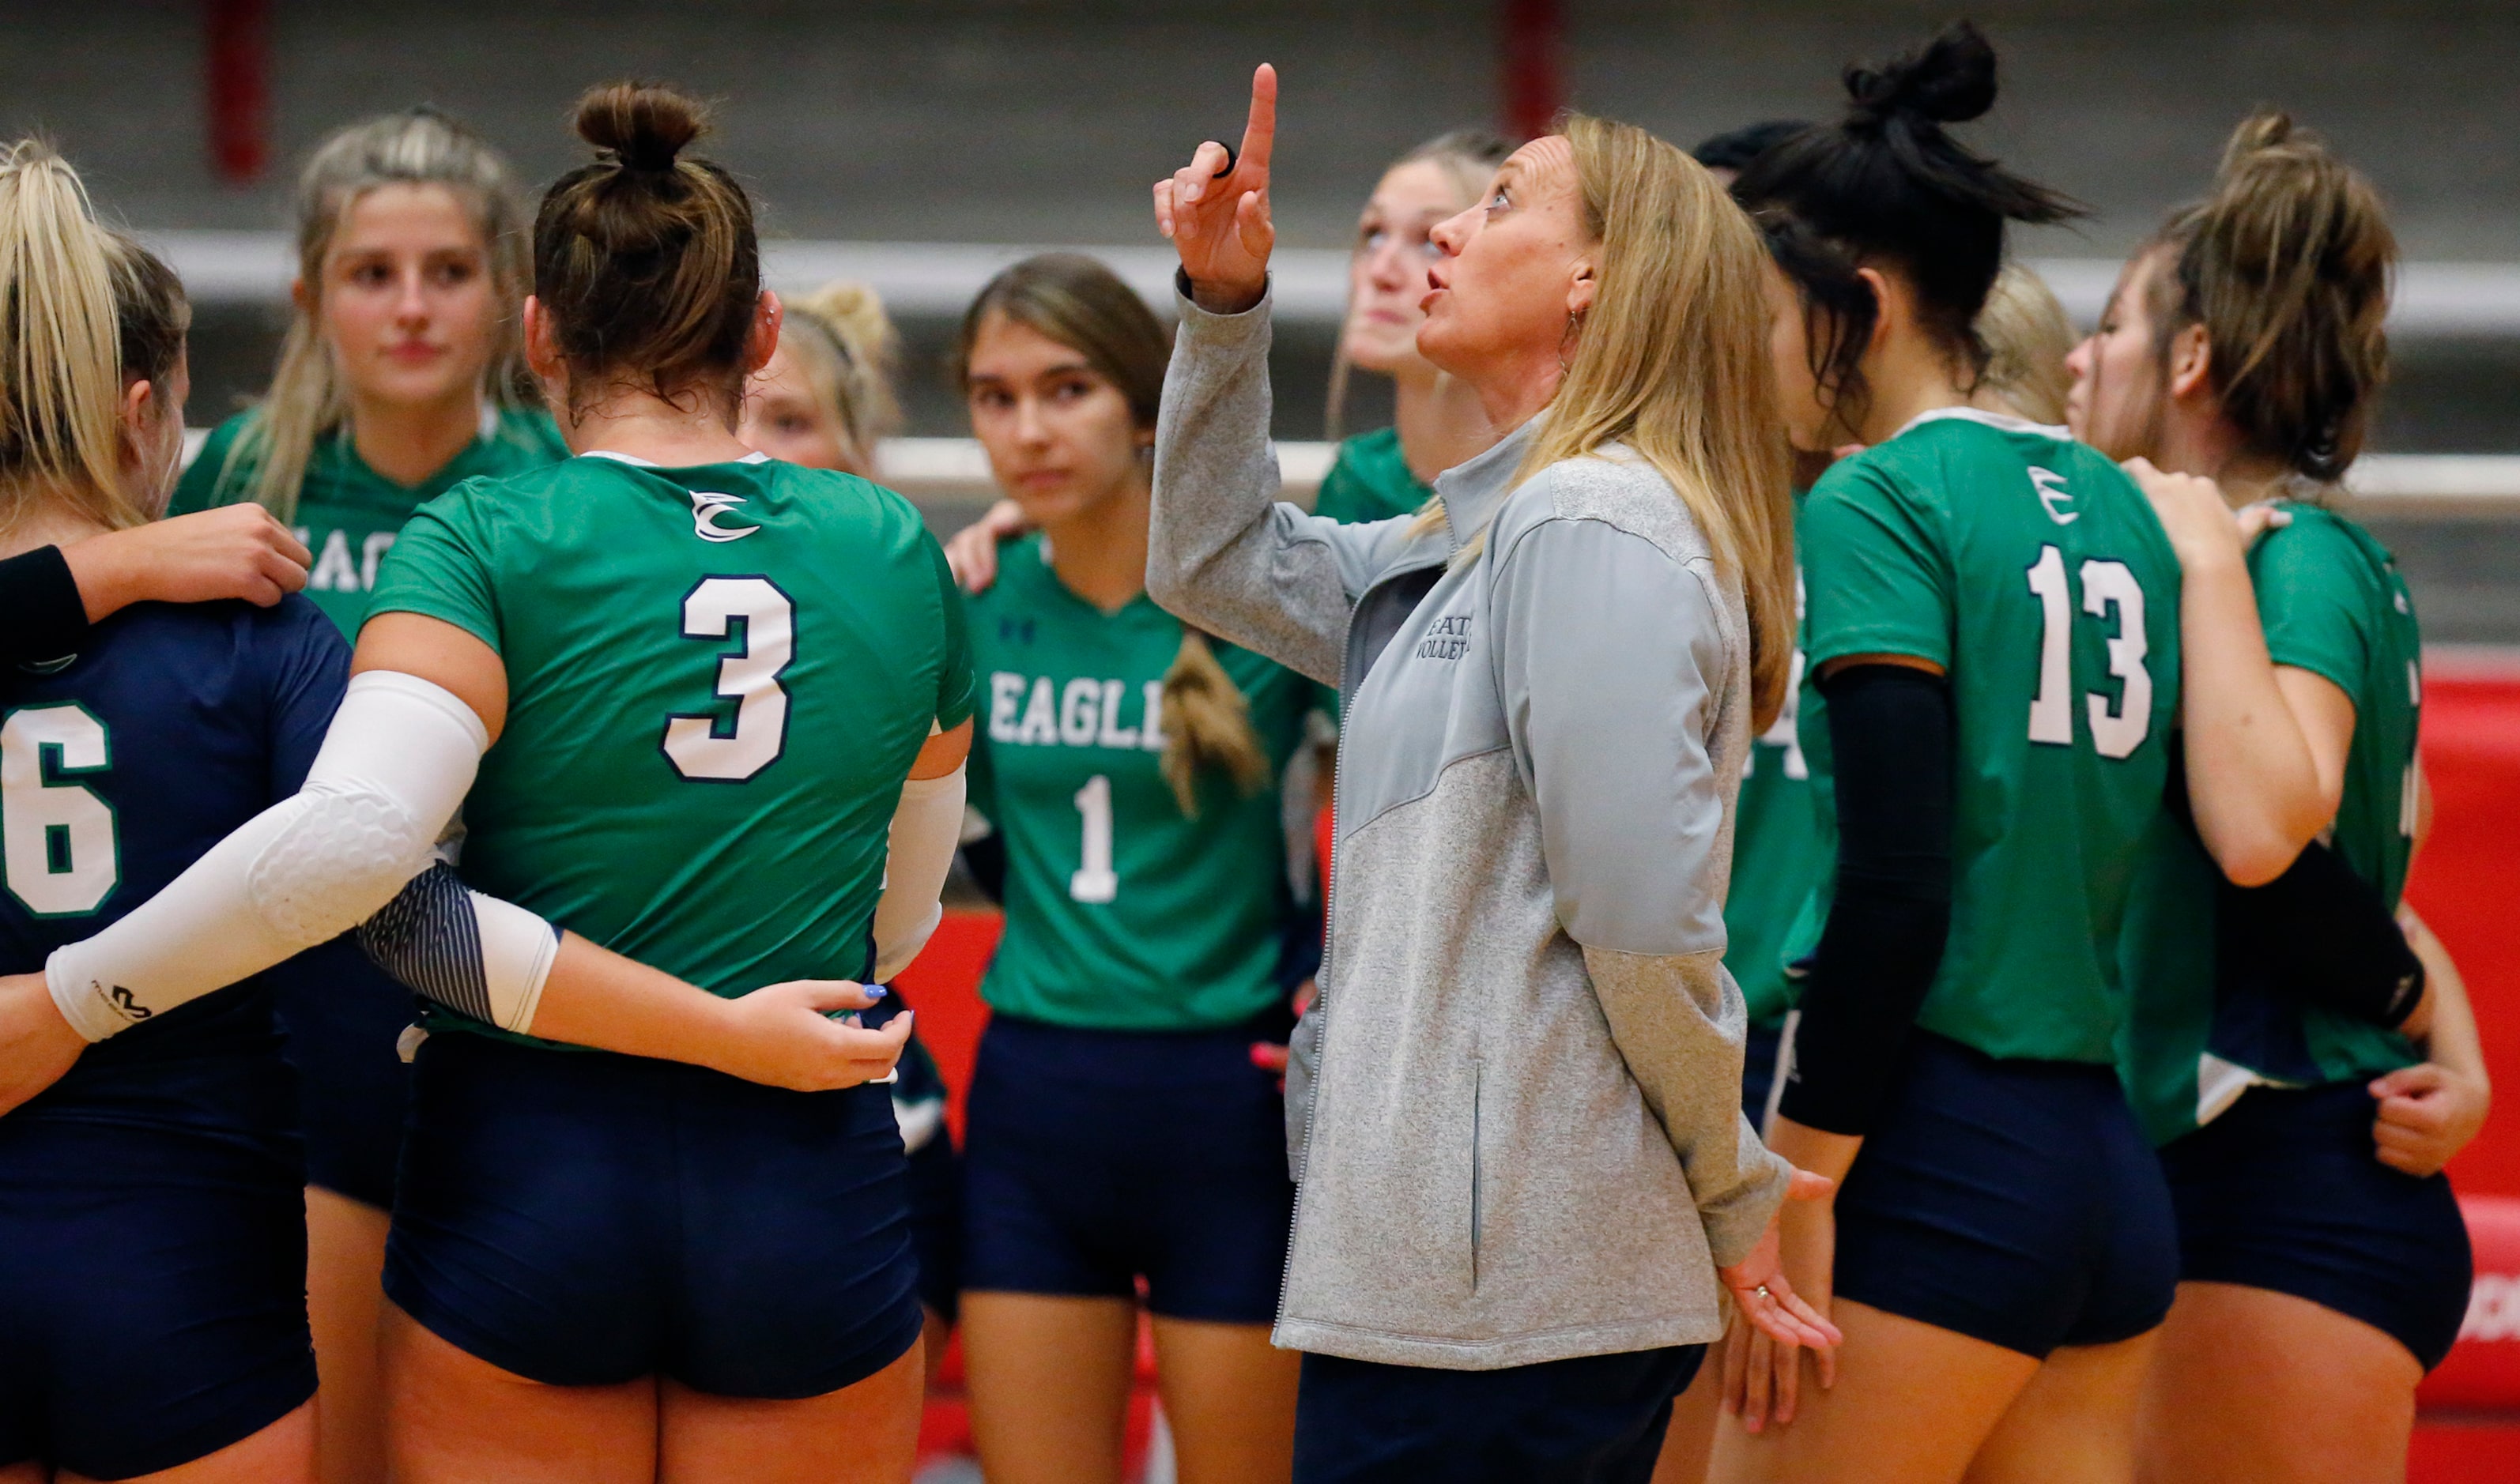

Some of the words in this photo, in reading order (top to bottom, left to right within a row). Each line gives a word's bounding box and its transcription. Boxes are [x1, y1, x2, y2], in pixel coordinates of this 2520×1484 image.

[659, 573, 796, 783] 3
[2026, 541, 2153, 760] 13
[0, 699, 123, 920] 6
[1069, 774, 1117, 903] 1
